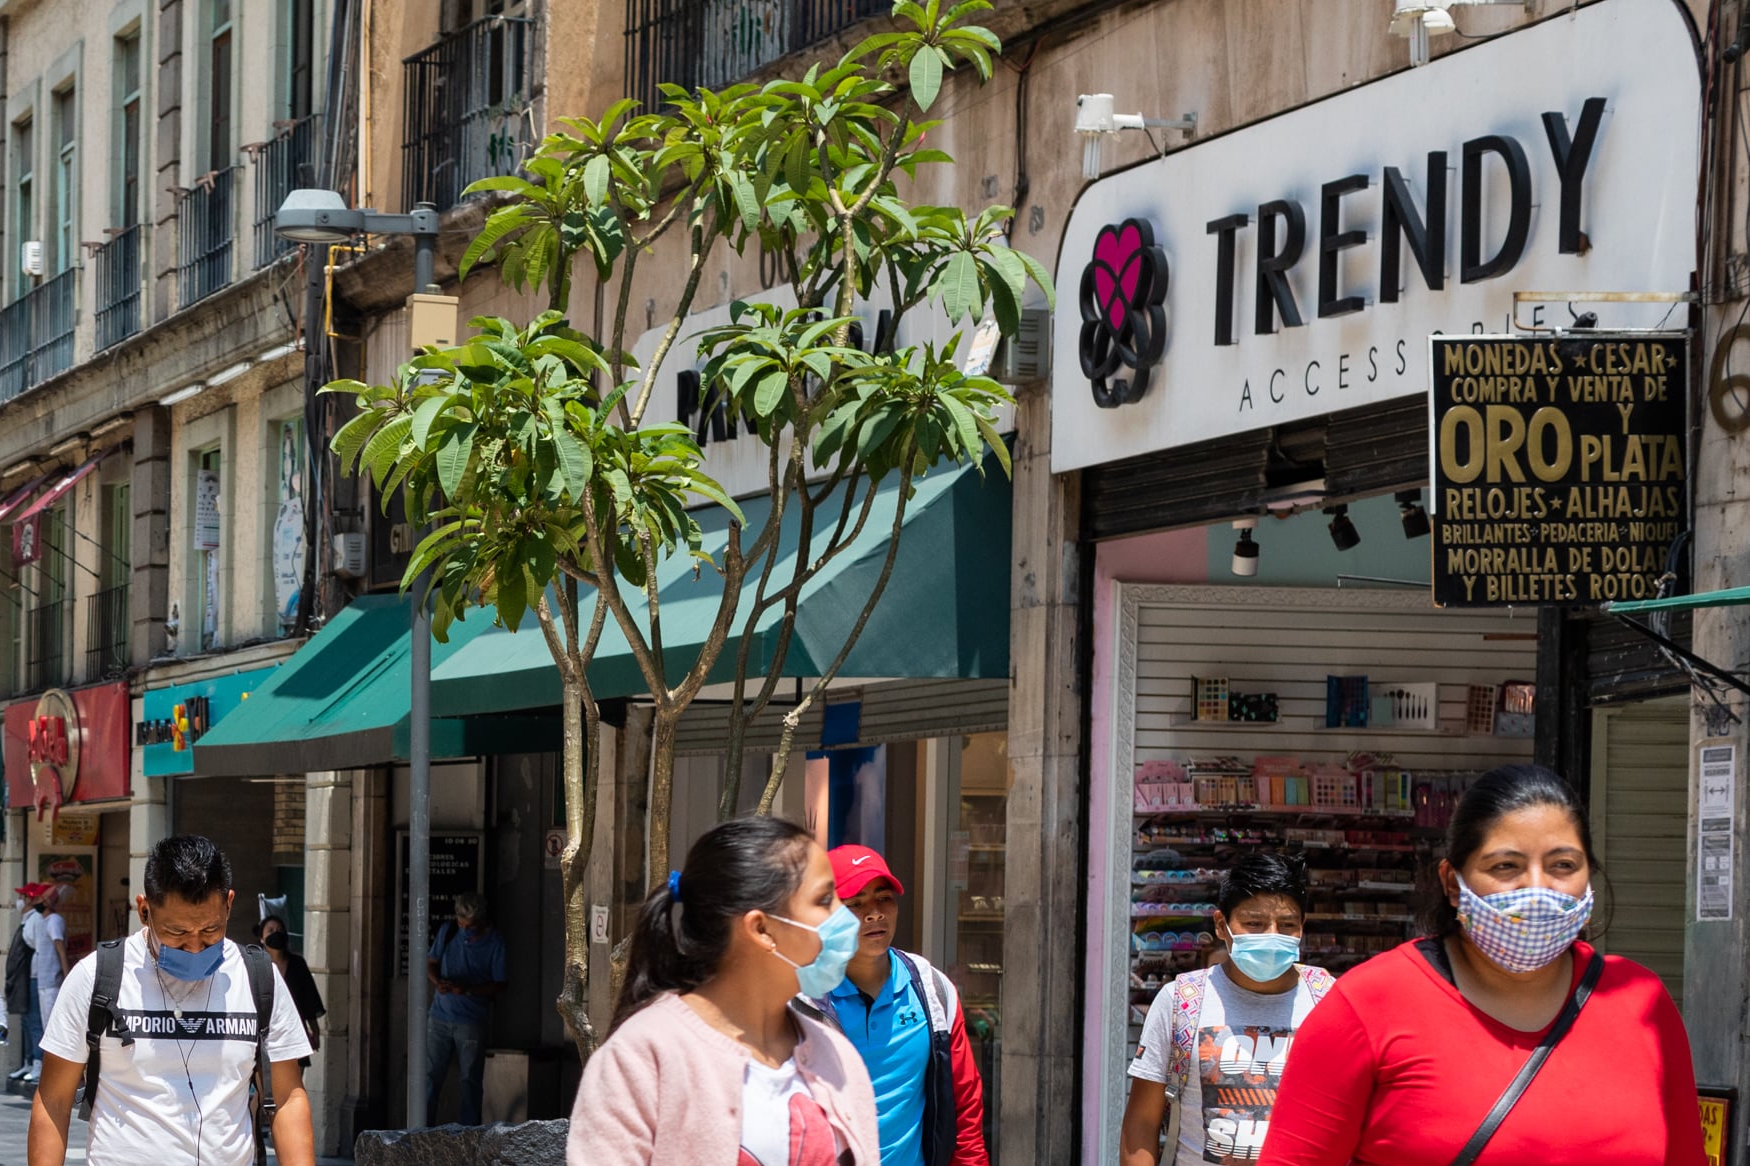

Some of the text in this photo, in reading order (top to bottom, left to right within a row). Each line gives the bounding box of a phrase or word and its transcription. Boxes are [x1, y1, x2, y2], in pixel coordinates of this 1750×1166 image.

[1207, 97, 1607, 346] TRENDY
[1444, 343, 1666, 376] MONEDAS CESAR
[1451, 375, 1668, 403] COMPRA Y VENTA DE
[1439, 402, 1686, 484] ORO Y PLATA
[1446, 486, 1680, 521] RELOJES ALHAJAS
[1442, 523, 1531, 545] BRILLANTES
[1540, 522, 1620, 544] PEDACERIA
[1448, 548, 1559, 575] MORRALLA
[1569, 547, 1592, 573] DE
[1463, 575, 1477, 601] Y
[1487, 573, 1577, 601] BILLETES
[205, 1017, 257, 1036] ARMANI
